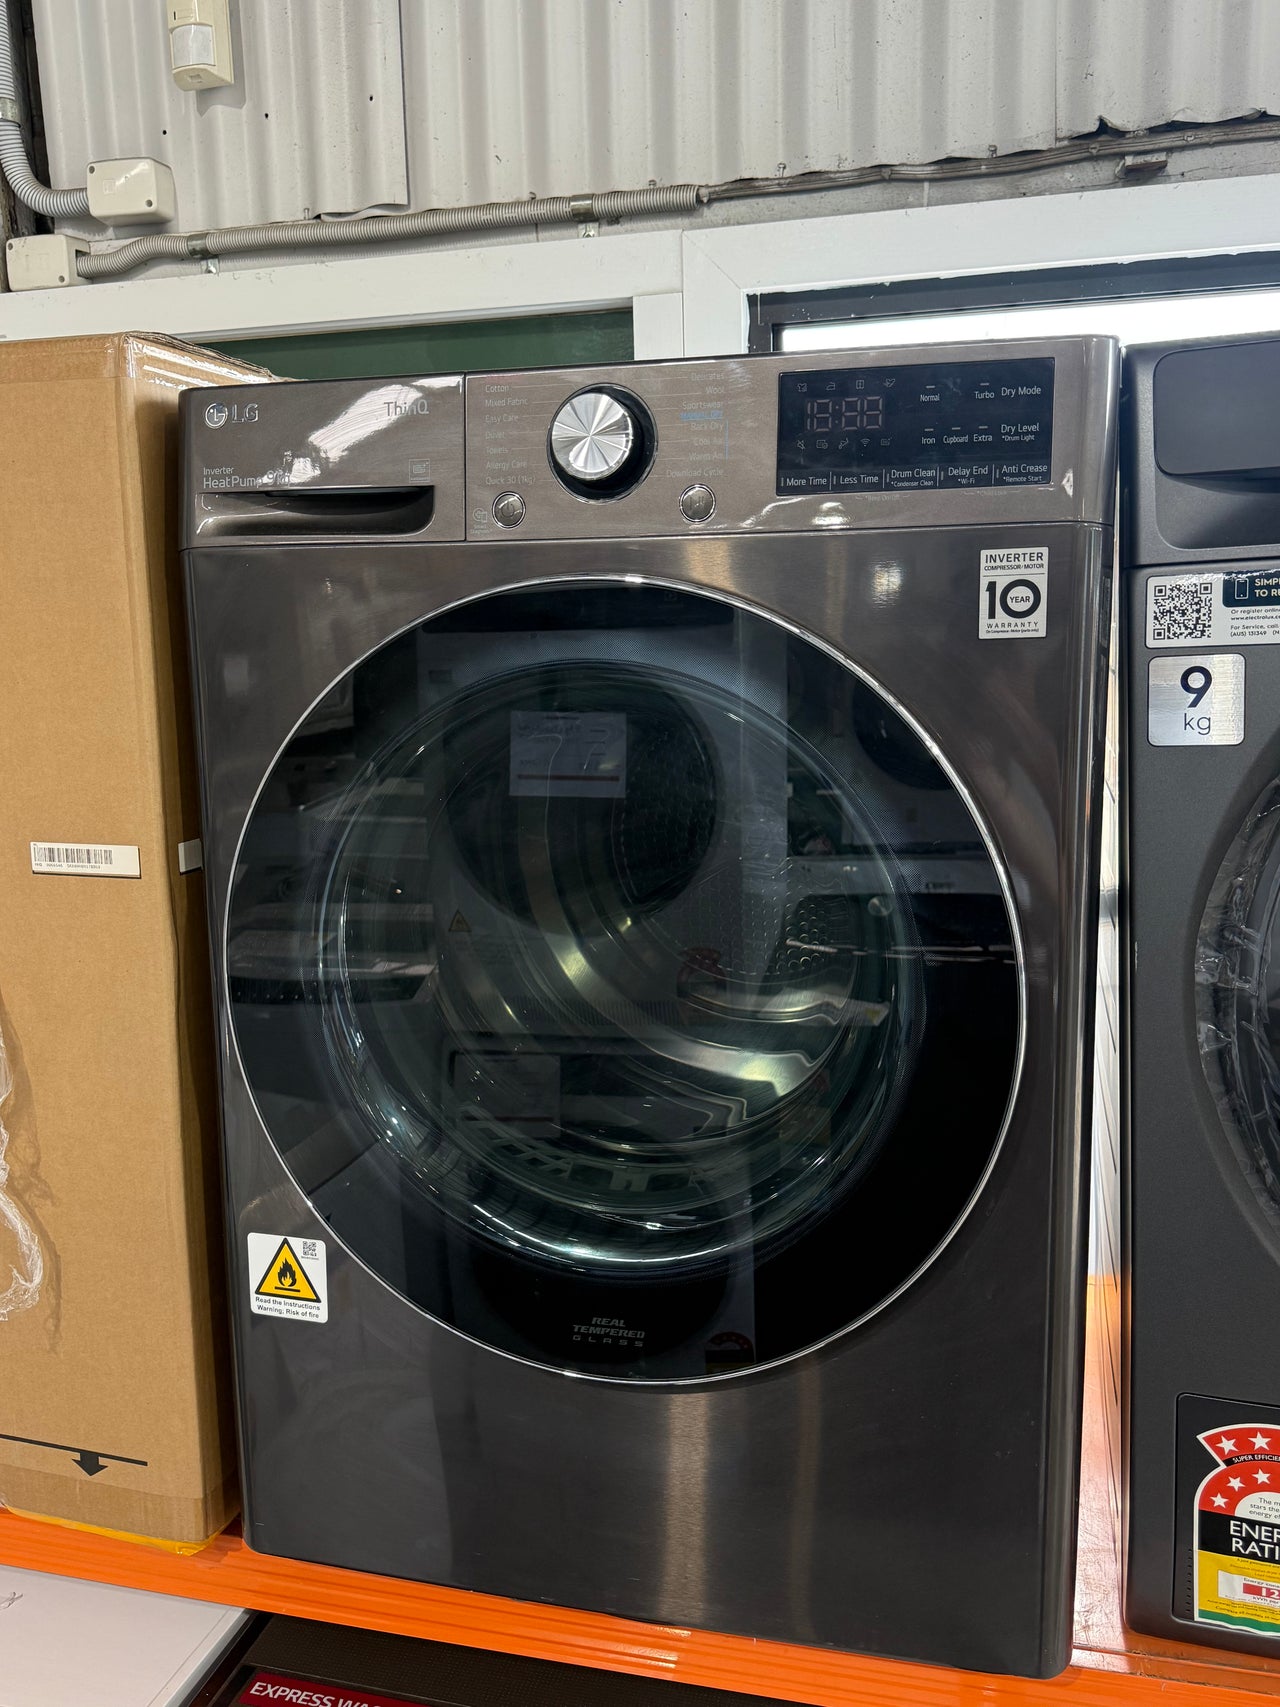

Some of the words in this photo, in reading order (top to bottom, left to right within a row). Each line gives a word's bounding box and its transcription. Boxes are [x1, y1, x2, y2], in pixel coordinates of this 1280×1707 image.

[485, 384, 510, 393] Cotton
[705, 386, 725, 394] Wool
[1001, 387, 1016, 397] Dry
[1018, 386, 1042, 395] Mode
[920, 393, 940, 402] Normal
[974, 391, 995, 399] Turbo
[485, 399, 506, 407] Mixed
[507, 397, 529, 406] Fabric
[682, 401, 724, 411] Sportswear
[383, 399, 429, 416] ThinQ
[231, 403, 259, 423] LG
[485, 415, 501, 425] Easy
[503, 414, 519, 422] Care
[1001, 424, 1016, 434] Dry
[1018, 423, 1040, 432] Level
[921, 436, 936, 444] Iron
[943, 435, 969, 444] Cupboard
[973, 434, 993, 442] Extra
[1021, 434, 1035, 442] Light
[486, 461, 510, 471] Allergy
[511, 460, 528, 468] Care
[1001, 464, 1019, 473] Anti
[1020, 464, 1048, 473] Crease
[203, 466, 234, 476] Inverter
[666, 469, 701, 478] Download
[703, 467, 723, 477] Cycle
[891, 469, 913, 479] Drum
[914, 468, 936, 477] Clean
[948, 467, 971, 477] Delay
[972, 465, 989, 475] End
[486, 477, 506, 486] Quick
[507, 476, 517, 484] 30
[518, 475, 536, 486] (1kg)
[786, 478, 807, 486] More
[809, 476, 827, 486] Time
[840, 475, 858, 484] Less
[860, 474, 879, 483] Time
[985, 552, 1044, 564] INVERTER
[1254, 588, 1268, 597] TO
[985, 578, 1041, 619] 10
[1010, 595, 1031, 604] YEAR
[986, 621, 1038, 629] WARRANTY
[1180, 665, 1213, 709] 9
[1183, 712, 1212, 735] kg
[255, 1296, 272, 1304] Read
[283, 1299, 321, 1311] Instructions
[286, 1308, 300, 1316] Risk
[308, 1311, 320, 1319] fire
[591, 1317, 626, 1328] REAL
[572, 1324, 645, 1338] TEMPERED
[572, 1334, 643, 1347] GLASS
[1232, 1454, 1254, 1463] SUPER
[1259, 1497, 1272, 1505] The
[1250, 1503, 1267, 1511] stars
[1249, 1510, 1272, 1519] energy
[1231, 1537, 1279, 1560] RATI
[250, 1681, 336, 1707] EXPRESS
